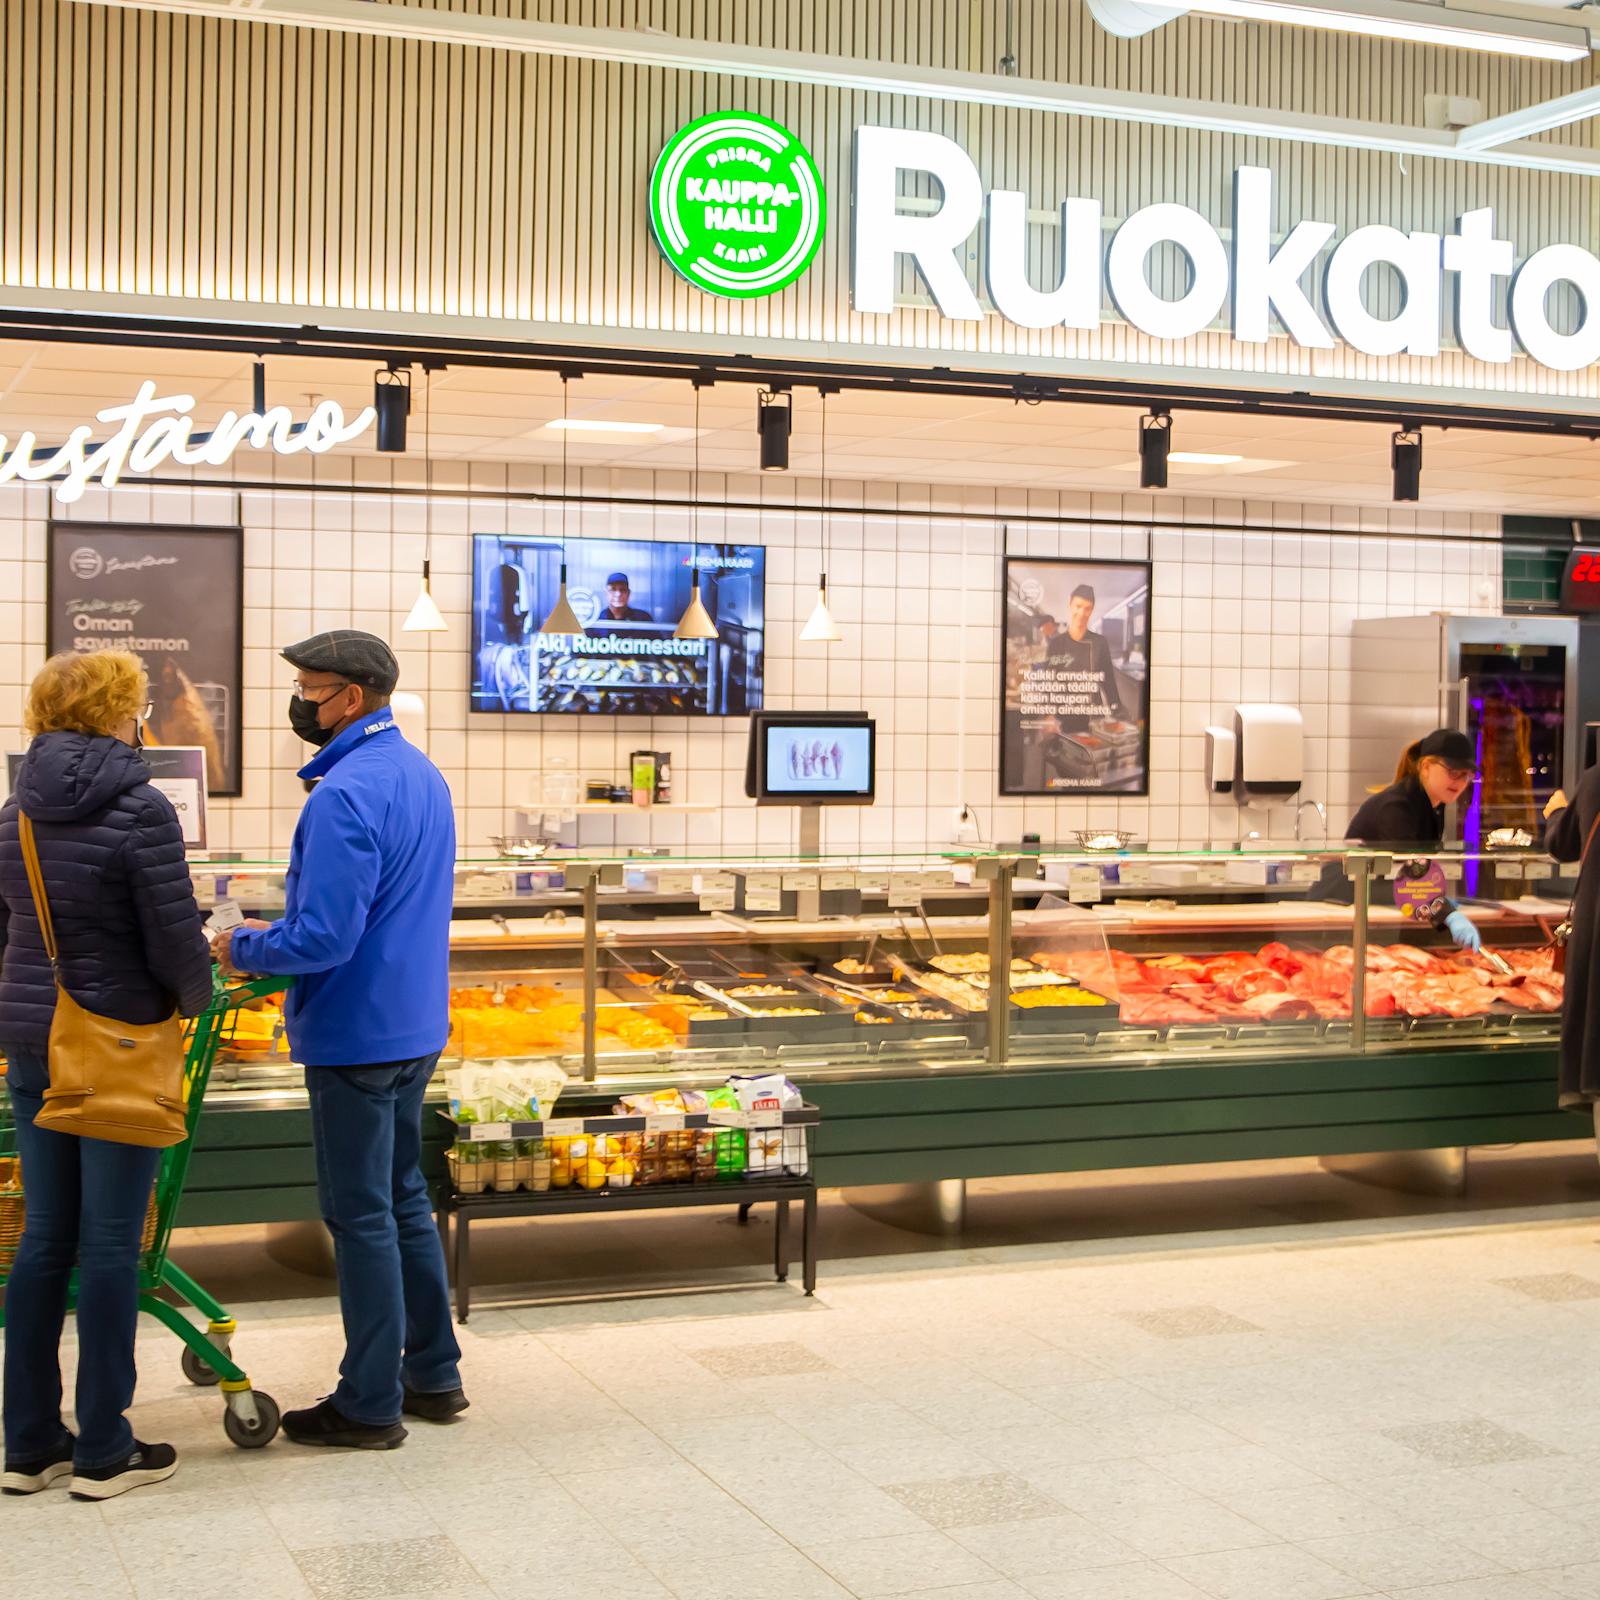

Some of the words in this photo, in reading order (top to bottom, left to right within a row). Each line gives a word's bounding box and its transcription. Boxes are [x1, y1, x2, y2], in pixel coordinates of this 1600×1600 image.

[705, 146, 771, 173] PRISMA
[685, 177, 799, 207] KAUPPA-
[704, 206, 778, 233] HALLI
[713, 242, 767, 263] KAARI
[73, 614, 133, 632] Oman
[572, 633, 706, 656] Ruokamestari
